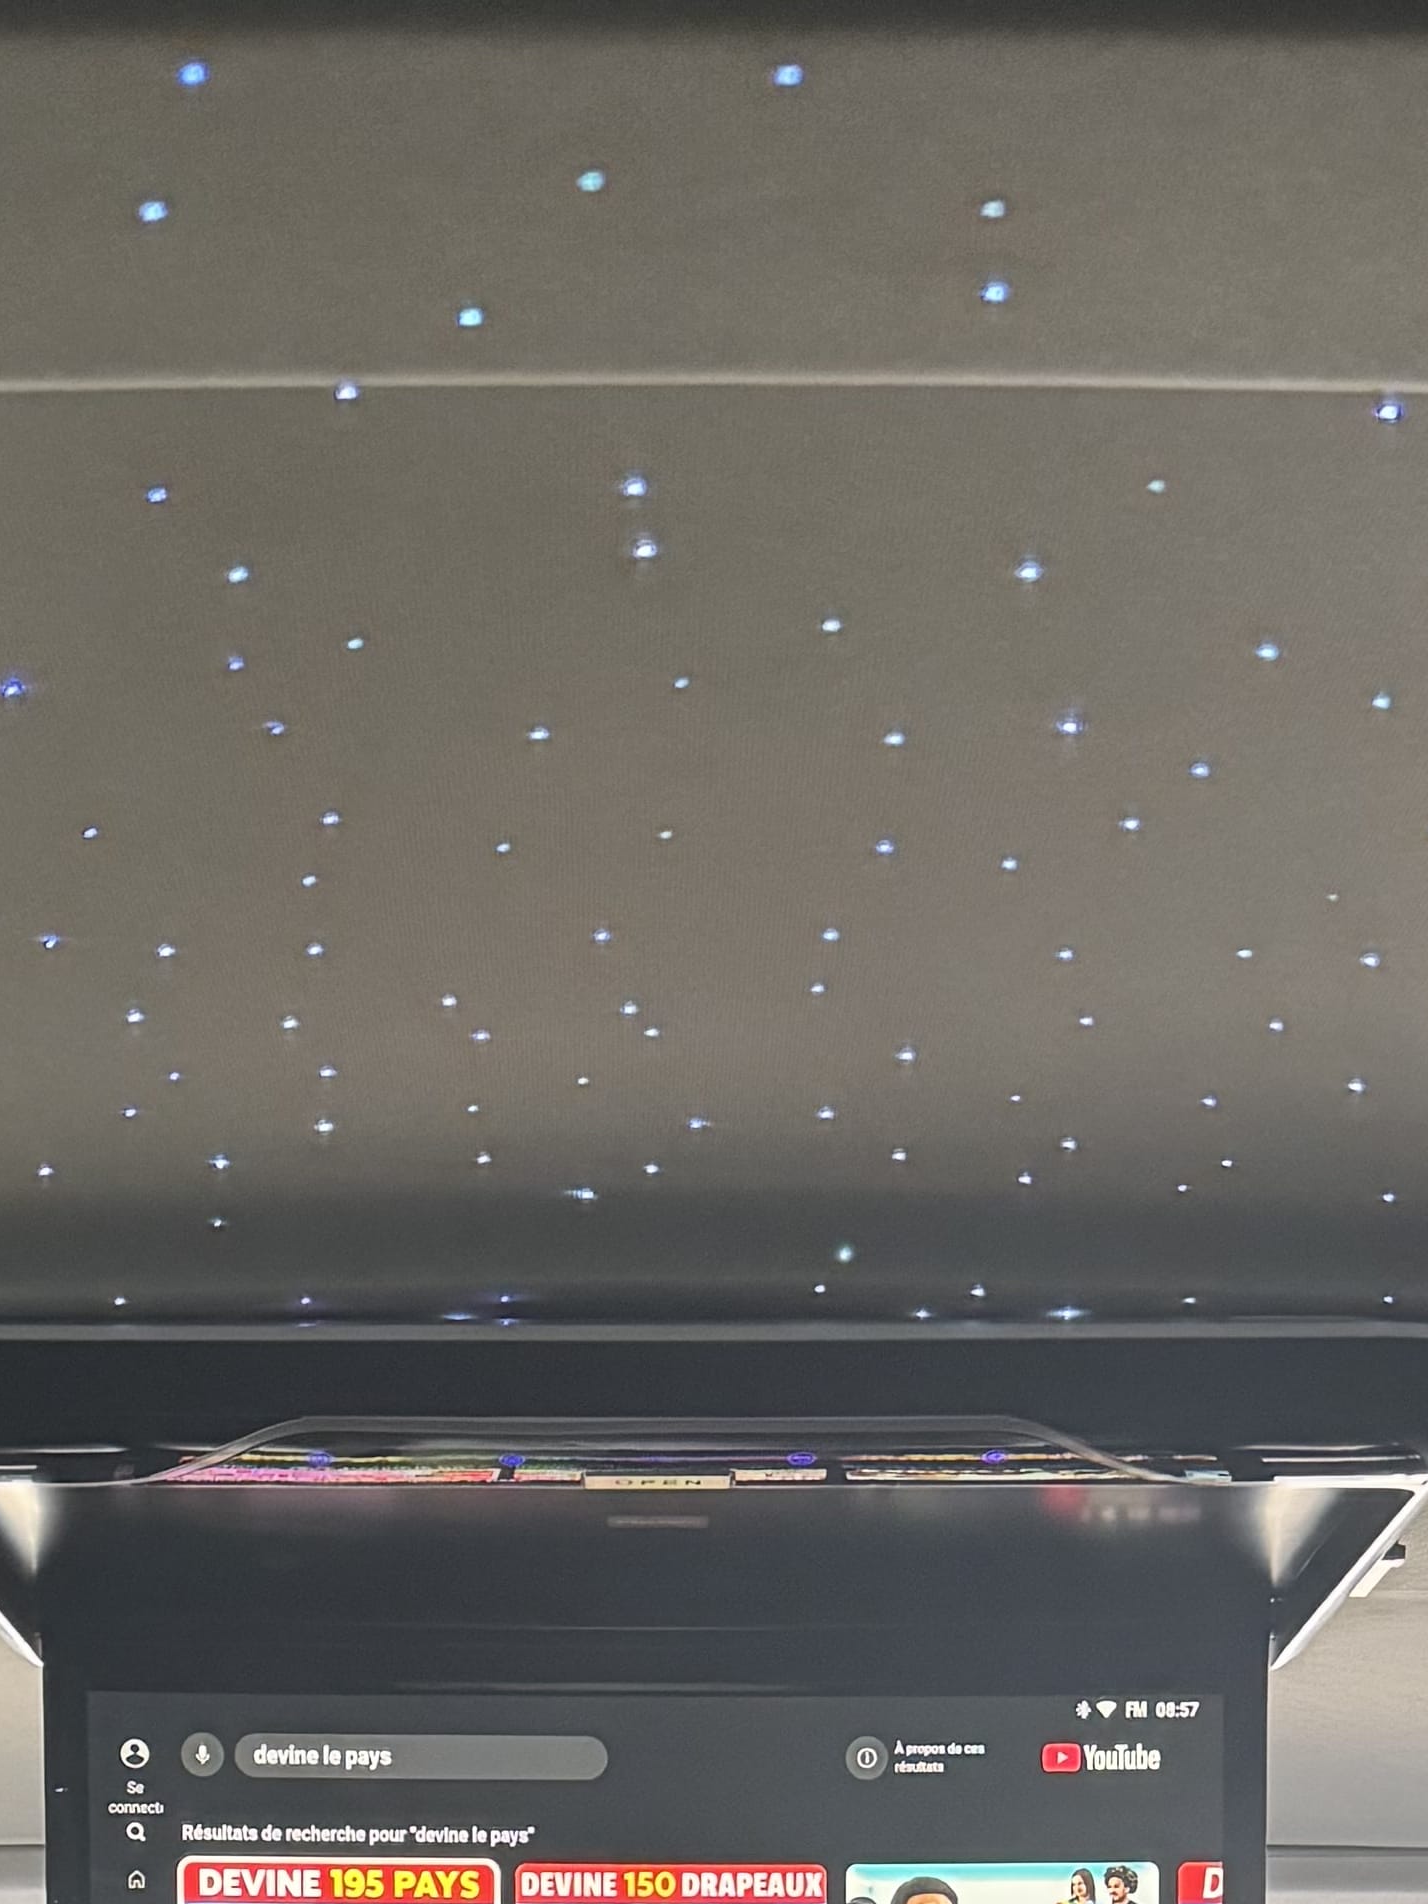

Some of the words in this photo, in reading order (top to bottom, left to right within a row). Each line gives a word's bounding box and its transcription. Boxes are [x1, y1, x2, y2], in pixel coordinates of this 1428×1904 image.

[1125, 1701, 1149, 1719] FM
[1155, 1701, 1200, 1718] 08:57
[253, 1743, 320, 1765] devine
[322, 1744, 342, 1766] le
[345, 1749, 392, 1771] pays
[1083, 1742, 1162, 1771] YouTube
[182, 1823, 259, 1842] Résultats
[260, 1823, 283, 1842] de
[285, 1824, 367, 1843] recherche
[368, 1828, 408, 1847] pour
[471, 1825, 488, 1844] le
[198, 1868, 321, 1898] DEVINE
[329, 1869, 384, 1899] 195
[394, 1870, 480, 1900] PAYS
[521, 1871, 617, 1897] DEVINE
[623, 1871, 676, 1898] 150
[681, 1872, 822, 1898] DRAPEAUX
